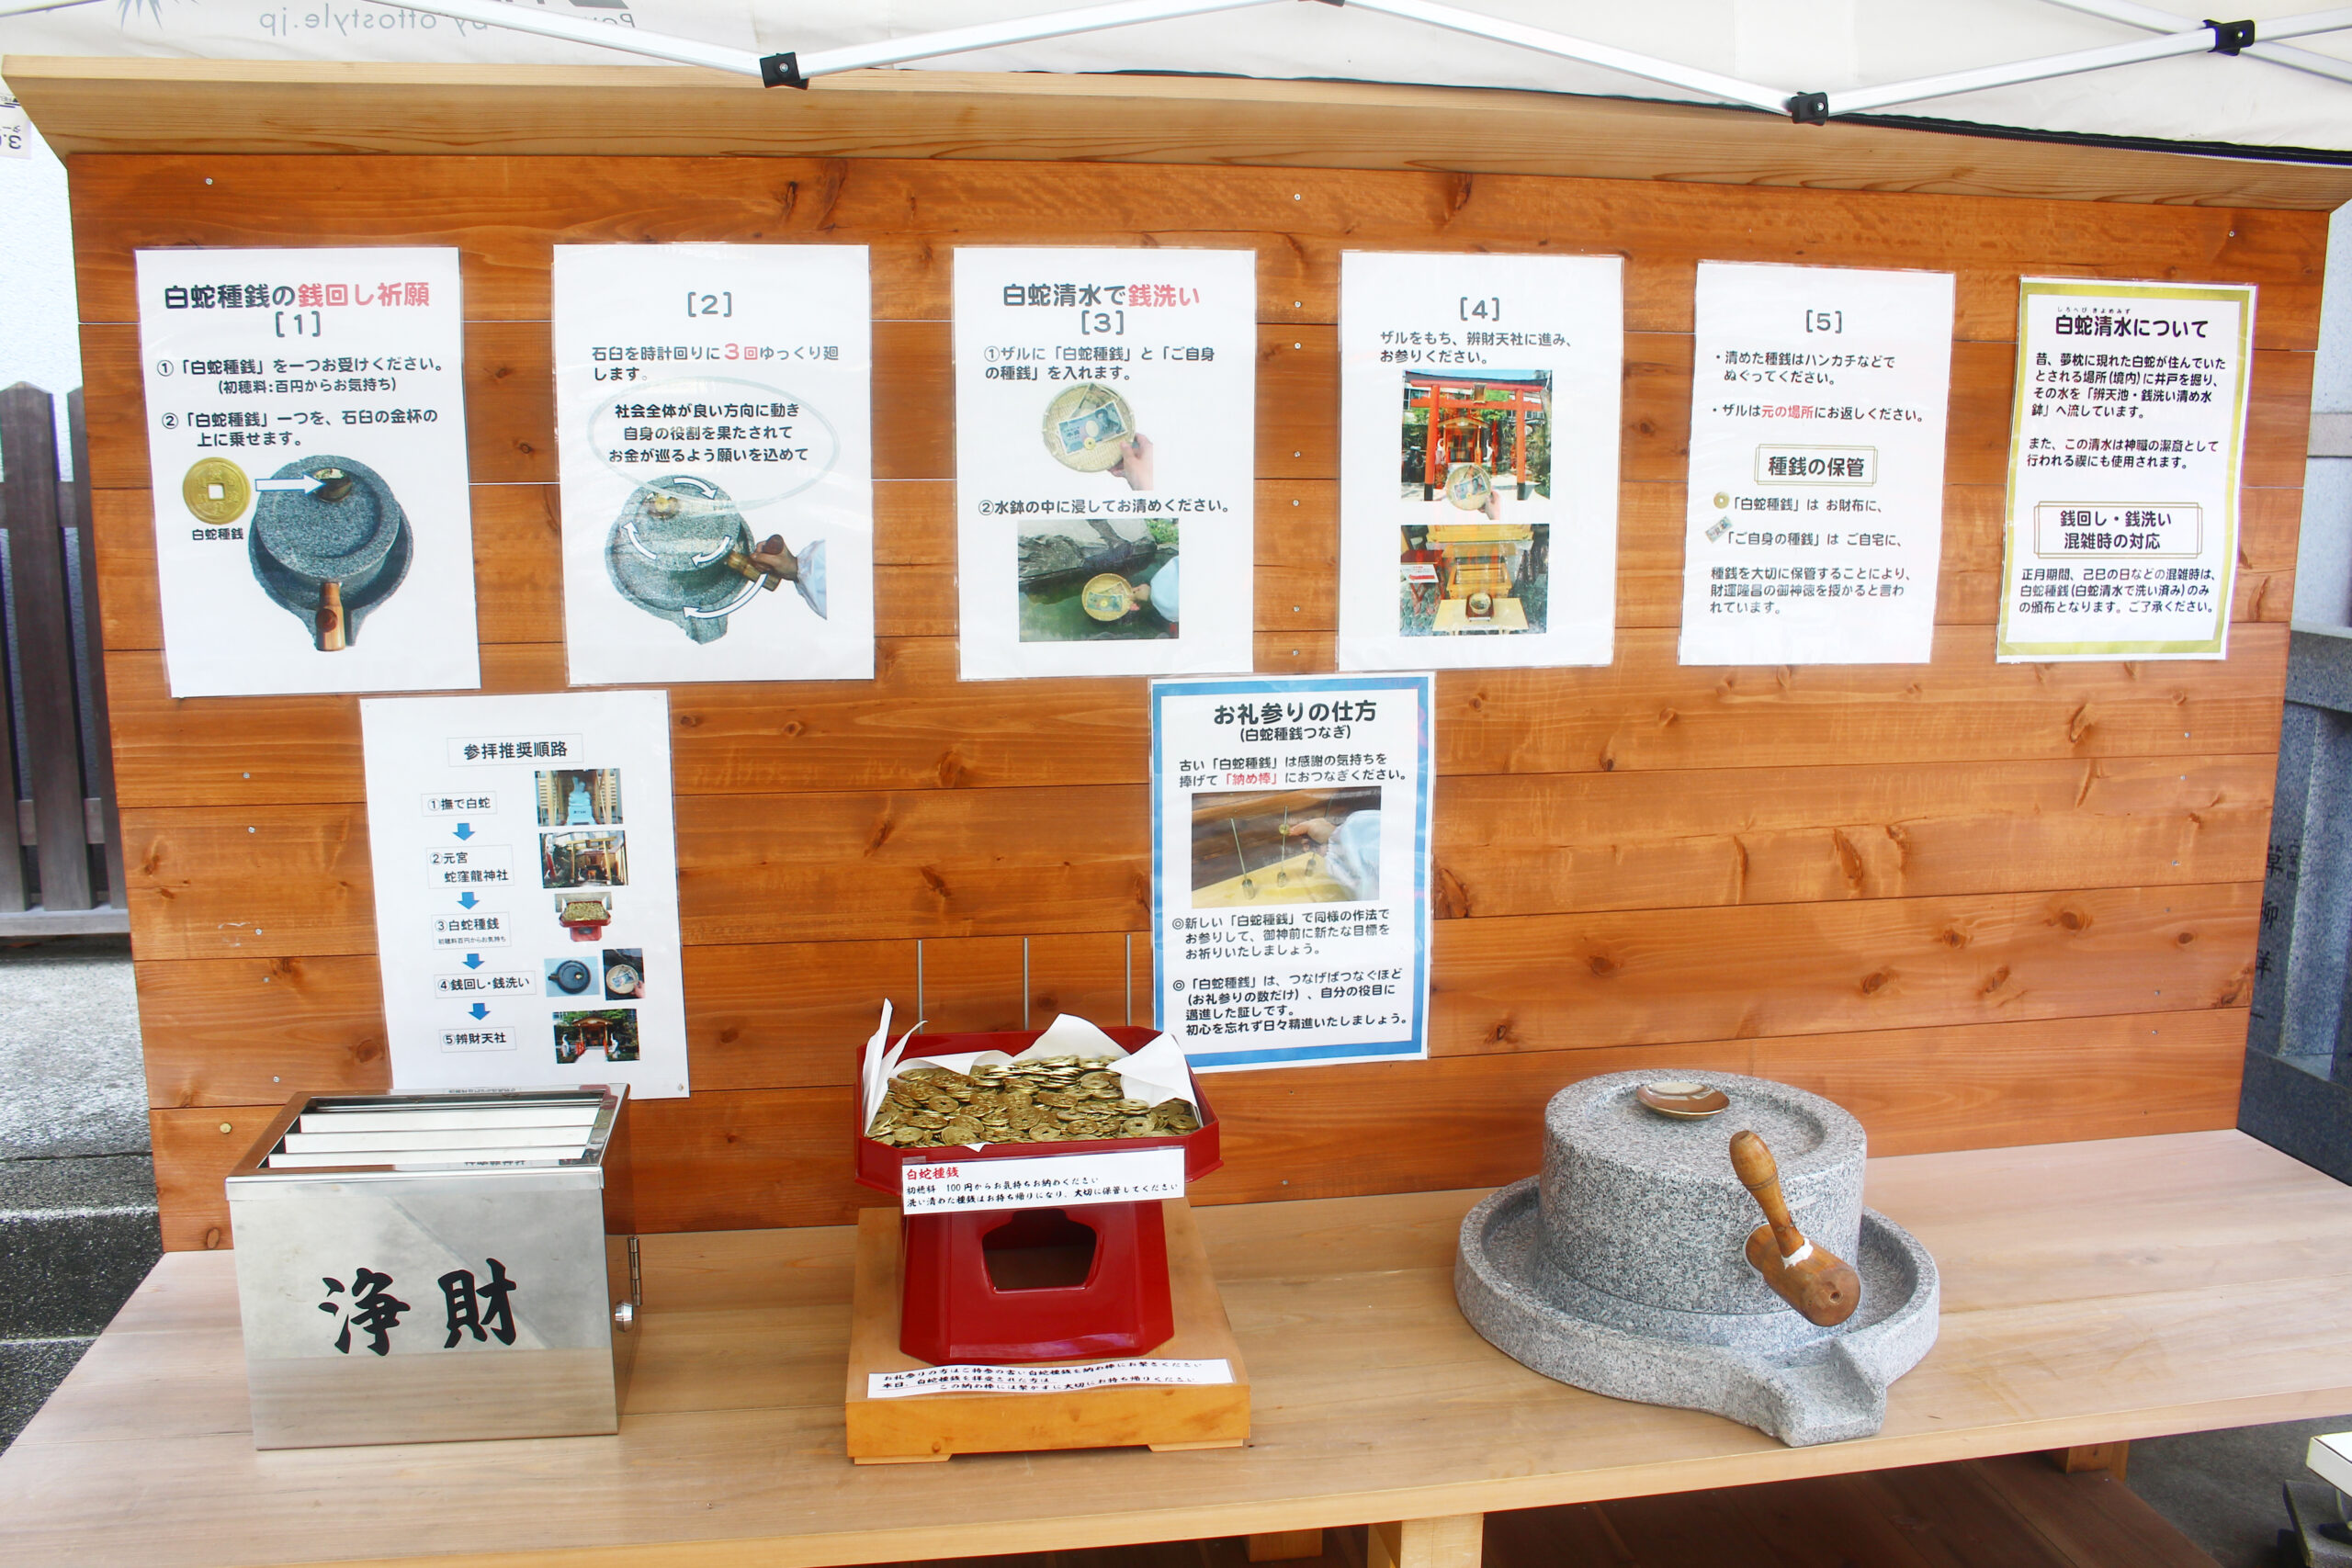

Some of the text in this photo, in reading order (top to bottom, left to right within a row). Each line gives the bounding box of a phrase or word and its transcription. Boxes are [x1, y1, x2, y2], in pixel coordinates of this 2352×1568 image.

[164, 282, 430, 309] 白蛇種銭の銭回し祈願
[1003, 284, 1200, 308] 白蛇清水で銭洗い
[687, 292, 731, 317] [2]
[1460, 297, 1500, 321] [4]
[275, 311, 321, 337] [1]
[1081, 310, 1125, 335] [3]
[1805, 310, 1842, 333] [5]
[2055, 315, 2209, 338] 白蛇清水について
[592, 343, 839, 361] 石臼を時計回りに3回ゆっくり廻
[984, 345, 1215, 363] ①ザルに「白蛇種銭」と「ご自身
[1380, 350, 1488, 364] お参りください。
[156, 356, 444, 377] ①「白蛇種銭」を一つお受けください。
[2036, 353, 2226, 369] 昔、夢枕に現れた白蛇が住んでいた
[594, 367, 649, 381] します。
[985, 365, 1132, 381] の種銭」を入れます。
[1724, 369, 1835, 385] ぬぐってください。
[219, 378, 396, 395] (初穂料:百円からお気持ち)
[161, 408, 437, 430] ②「白蛇種銭」一つを、石臼の金杯の
[615, 403, 799, 419] 社会全体が良い方向に動き
[2032, 404, 2144, 419] 鉢」へ流しています。
[197, 431, 302, 447] 上に乗せます。
[624, 426, 793, 441] 自身の役割を果たされて
[609, 448, 808, 463] お金が巡るよう願いを込めて
[2028, 454, 2188, 469] 行われる禊にも使用されます。
[1769, 457, 1864, 478] 種銭の保管
[978, 499, 1229, 515] ②水鉢の中に浸してお清めください。
[1733, 497, 1883, 513] 「白蛇種銭」は お財布に、
[2061, 511, 2171, 527] 銭回し・銭洗い
[192, 527, 243, 541] 白蛇種銭
[1727, 531, 1902, 547] 「ご自身の種銭」は ご自宅に、
[2064, 533, 2161, 549] 混雑時の対応
[1711, 567, 1911, 581] 種銭を大切に保管することにより、
[1710, 583, 1904, 597] 財運隆昌の御神徳を授かると言わ
[1710, 601, 1781, 615] れています。
[2019, 601, 2213, 614] の頒布となります。ご了承ください。
[1215, 700, 1376, 724] お礼参りの仕方
[1240, 725, 1351, 742] (白蛇種銭つなぎ)
[464, 741, 568, 760] 参拝推奨順路
[1179, 753, 1387, 772] 古い「白蛇種銭」は感謝の気持ちを
[1179, 769, 1406, 787] 捧げて「納め棒」におつなぎください。
[427, 797, 491, 811] ①撫で白蛇
[430, 852, 468, 865] ②元宮
[444, 869, 509, 883] 蛇窪龍神社
[435, 918, 499, 932] ③白蛇種銭
[1185, 924, 1390, 944] お参りして、御神前に新たな目標を
[1185, 943, 1321, 960] お祈りいたしましょう。
[436, 977, 529, 991] ④銭回し・銭洗い
[1186, 1005, 1295, 1021] 邁進した証しです。
[1186, 1013, 1407, 1036] 初心を忘れず日々精進いたしましょう。
[907, 1167, 959, 1180] 白蛇種銭
[318, 1258, 516, 1356] 浄財
